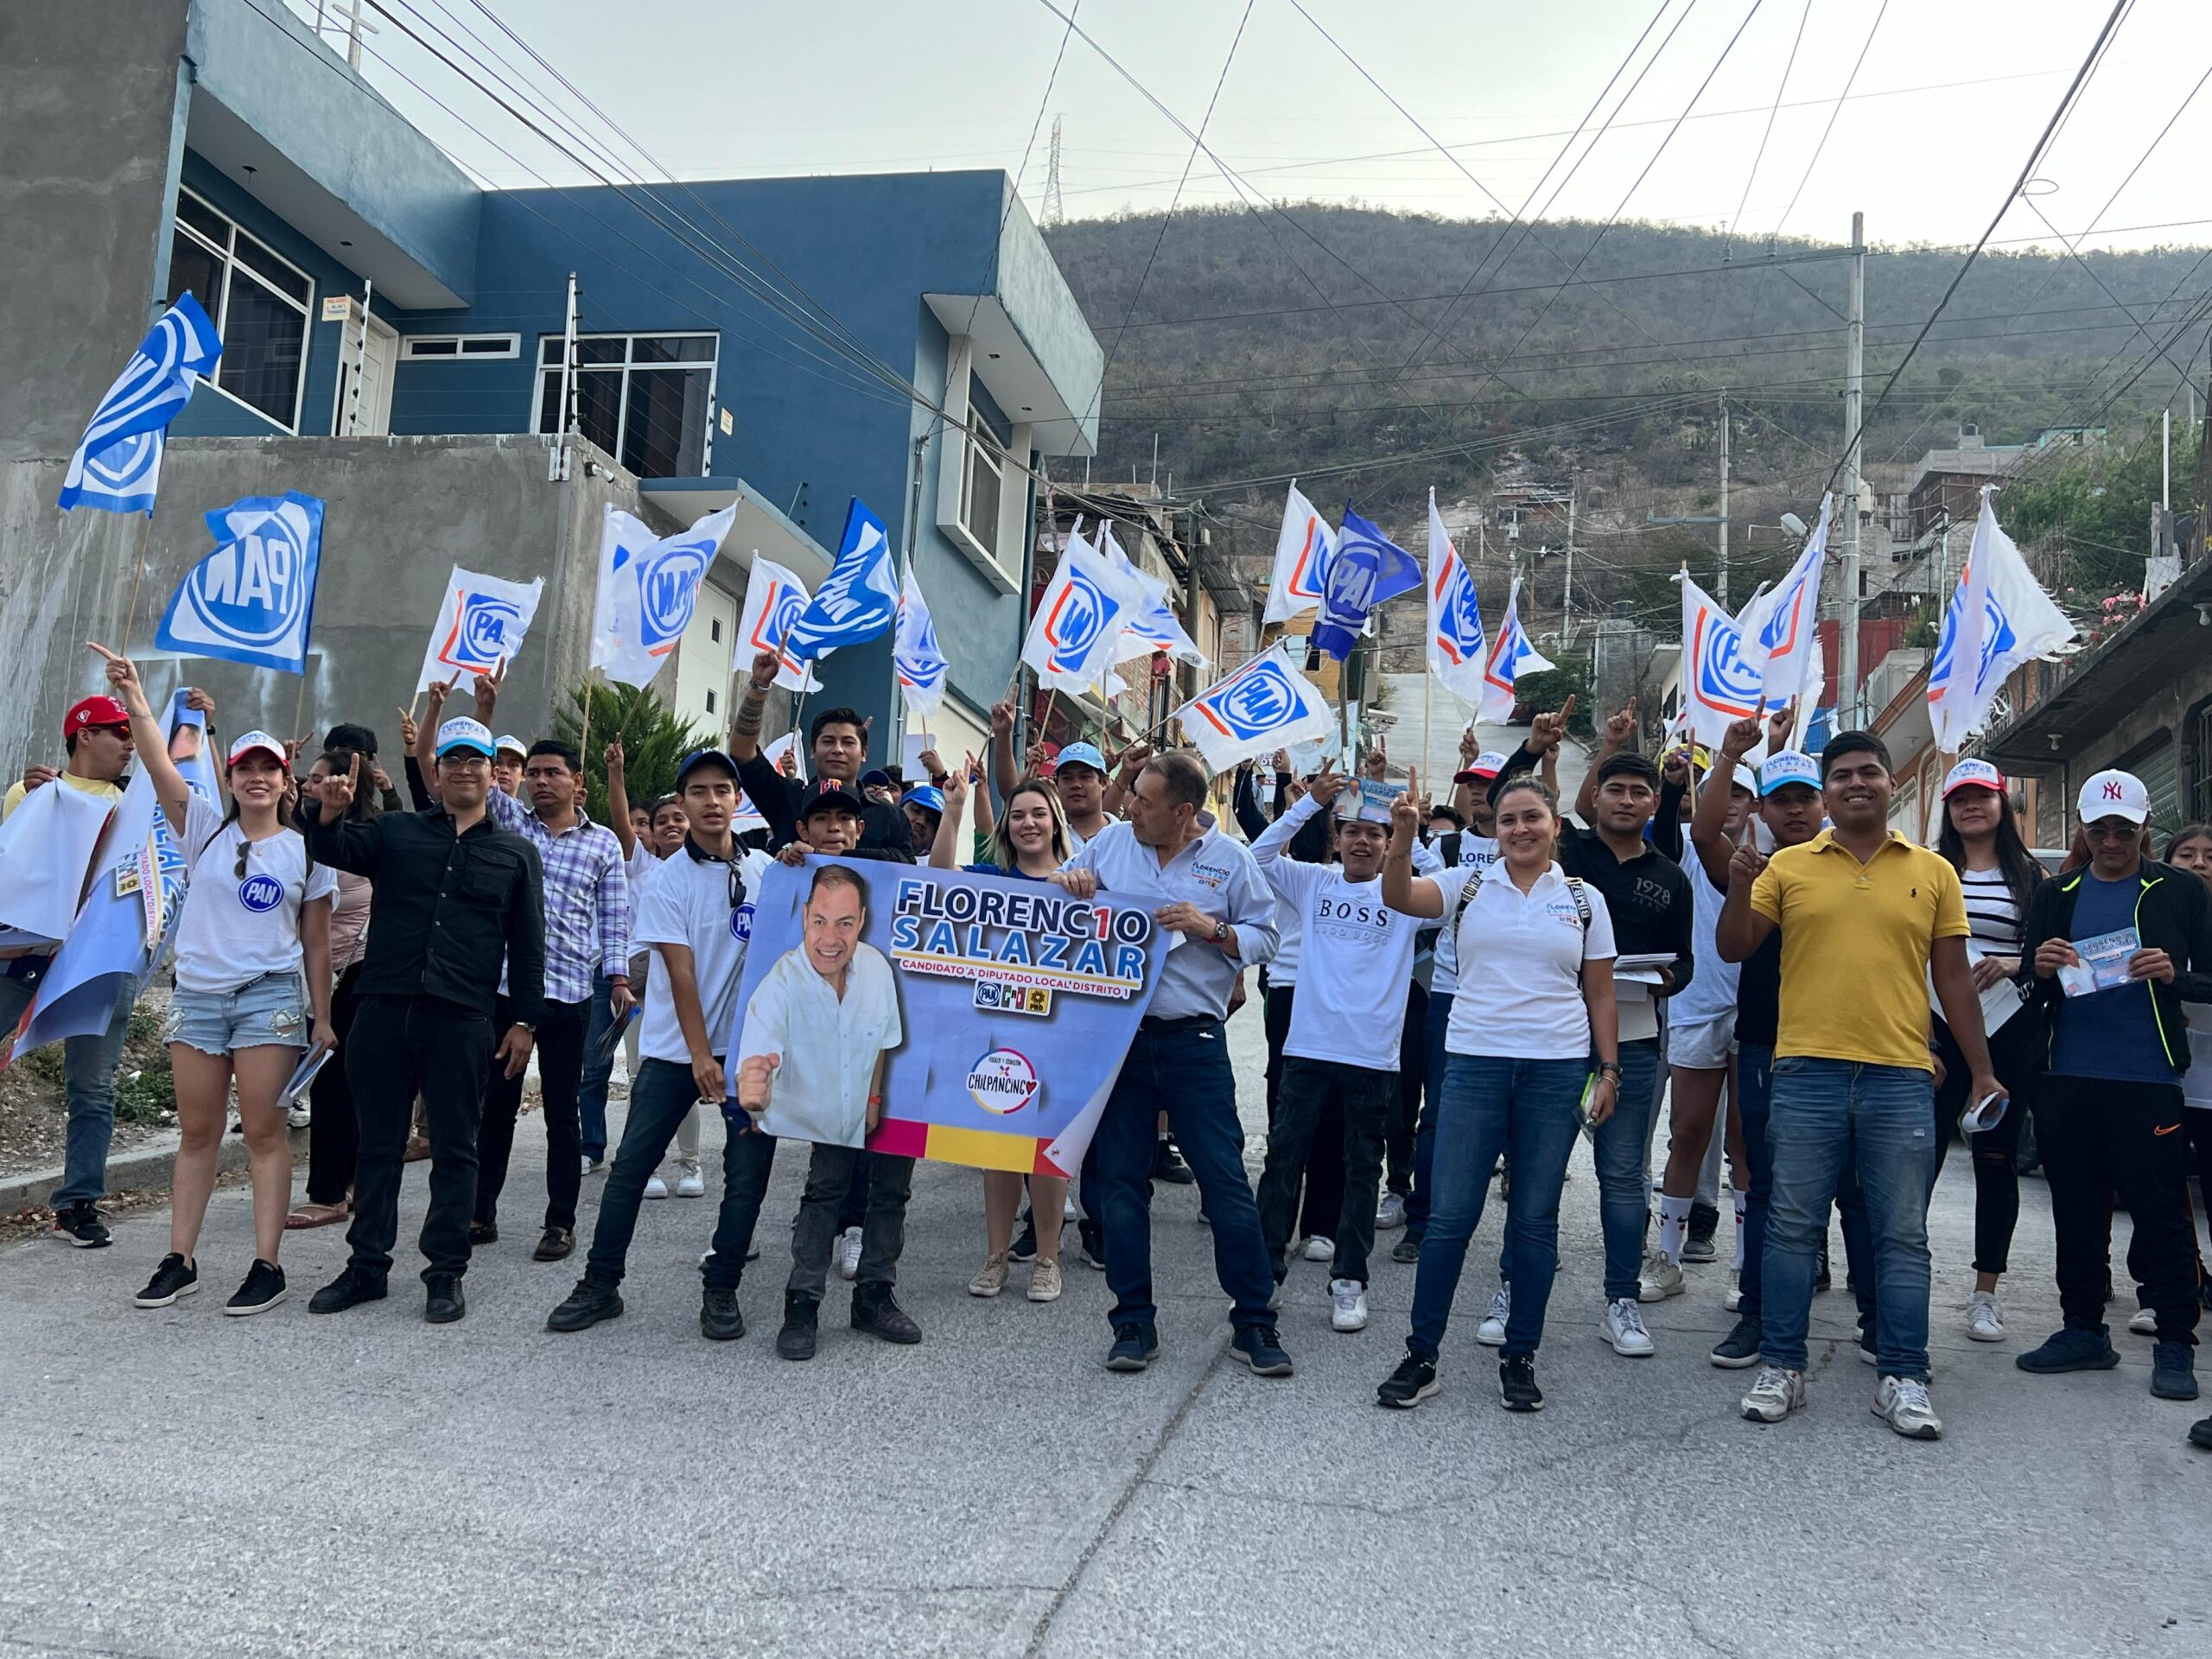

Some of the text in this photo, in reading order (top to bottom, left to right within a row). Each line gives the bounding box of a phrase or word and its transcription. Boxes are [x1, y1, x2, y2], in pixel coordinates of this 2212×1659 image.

[473, 611, 505, 645] PA
[1233, 677, 1284, 722] PAN
[1459, 852, 1495, 864] LORE
[245, 881, 278, 905] PAN
[1636, 876, 1671, 906] 1978
[737, 912, 752, 932] PA
[1320, 899, 1389, 927] BOSS
[892, 916, 1144, 981] SALAZAR
[902, 959, 965, 976] CANDIDATO
[978, 969, 1033, 984] DIPUTADO
[1035, 976, 1070, 989] LOCAL
[1073, 982, 1122, 996] DISTRITO
[981, 988, 997, 1001] PAN
